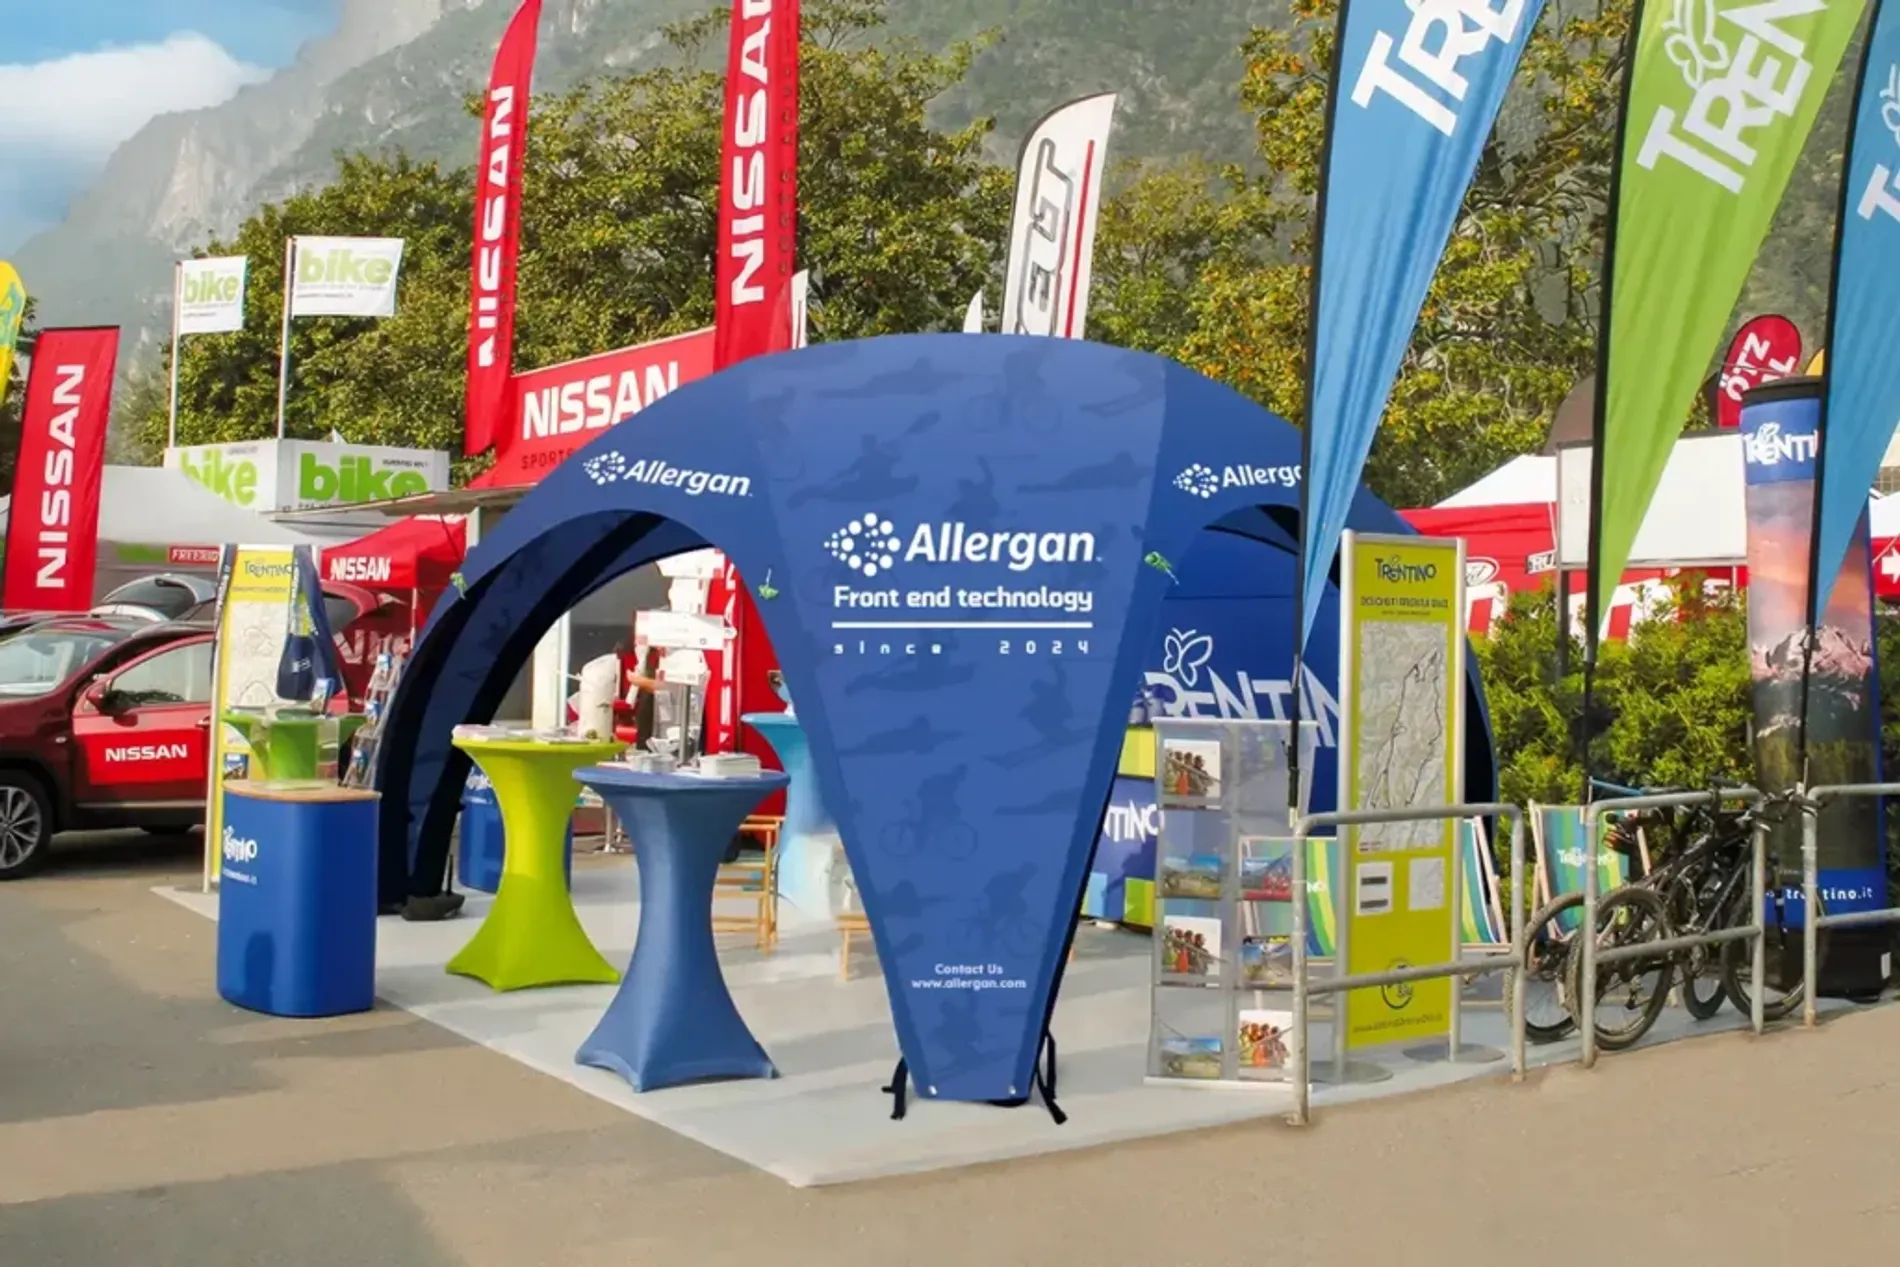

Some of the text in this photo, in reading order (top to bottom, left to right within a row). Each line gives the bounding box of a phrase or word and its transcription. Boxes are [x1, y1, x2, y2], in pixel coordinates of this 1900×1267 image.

[299, 249, 393, 284] bike
[183, 271, 240, 304] bike
[522, 361, 679, 441] NISSAN
[36, 364, 86, 588] NISSAN
[299, 452, 429, 502] bike
[623, 459, 751, 497] Allergan
[904, 521, 1096, 572] Allergan
[330, 557, 391, 581] NISSAN
[833, 585, 1093, 613] Front end technology
[999, 640, 1090, 654] 2024
[105, 743, 188, 762] NISSAN
[911, 978, 1027, 991] www.allergan.com
[934, 963, 1004, 975] Contact Us
